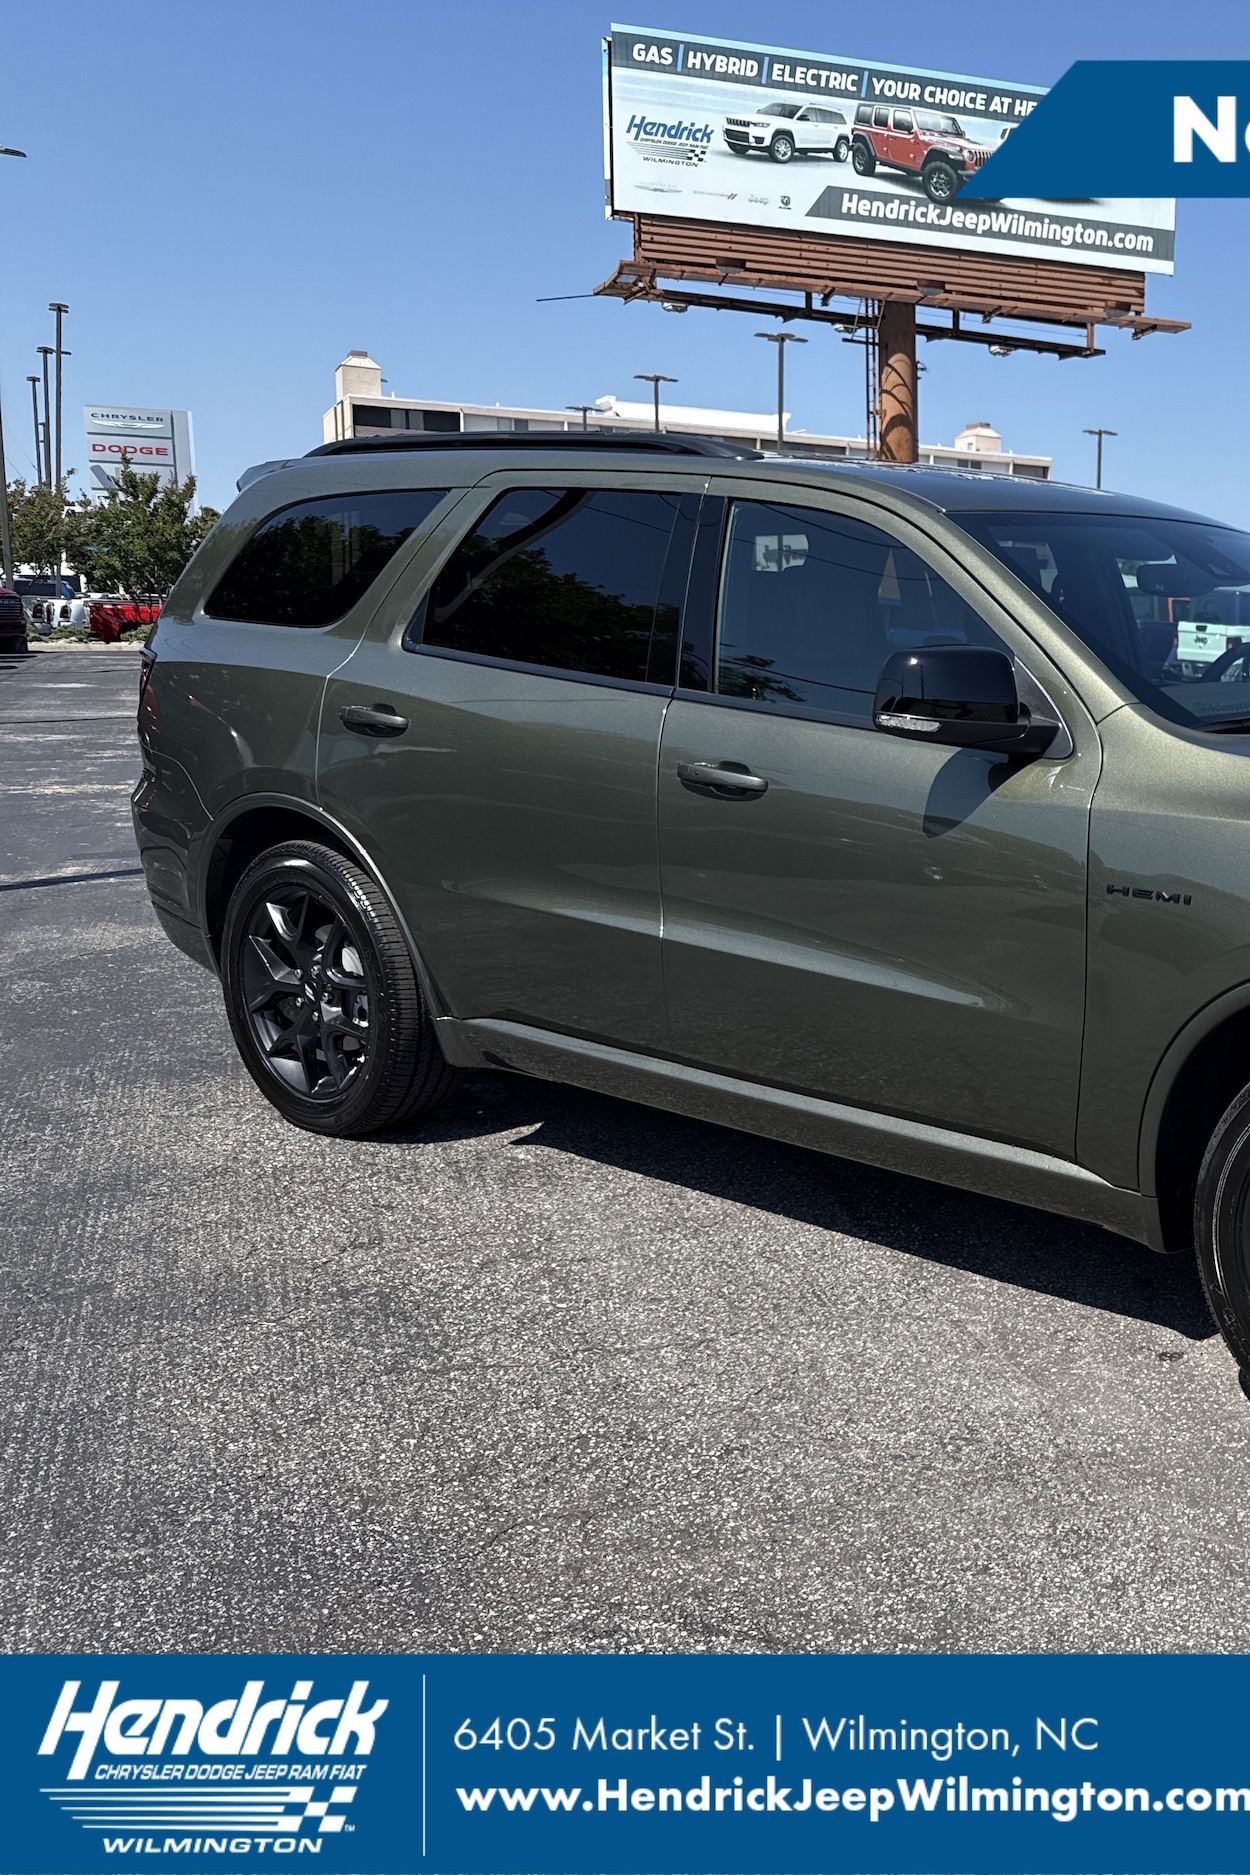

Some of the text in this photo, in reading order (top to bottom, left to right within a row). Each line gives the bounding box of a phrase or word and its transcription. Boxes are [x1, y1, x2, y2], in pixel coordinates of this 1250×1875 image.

[632, 43, 673, 65] GAS
[687, 50, 759, 77] HYBRID
[771, 63, 859, 92] ELECTRIC
[872, 77, 920, 101] YOUR
[923, 86, 987, 111] CHOICE
[989, 97, 1012, 114] AT
[626, 114, 714, 143] Hendrick
[643, 156, 698, 168] WILMINGTON
[841, 193, 1154, 252] HendrickJeepWilmington.com
[91, 413, 164, 422] CHRYSLER
[92, 443, 168, 456] DODGE
[1106, 883, 1193, 906] HEMI
